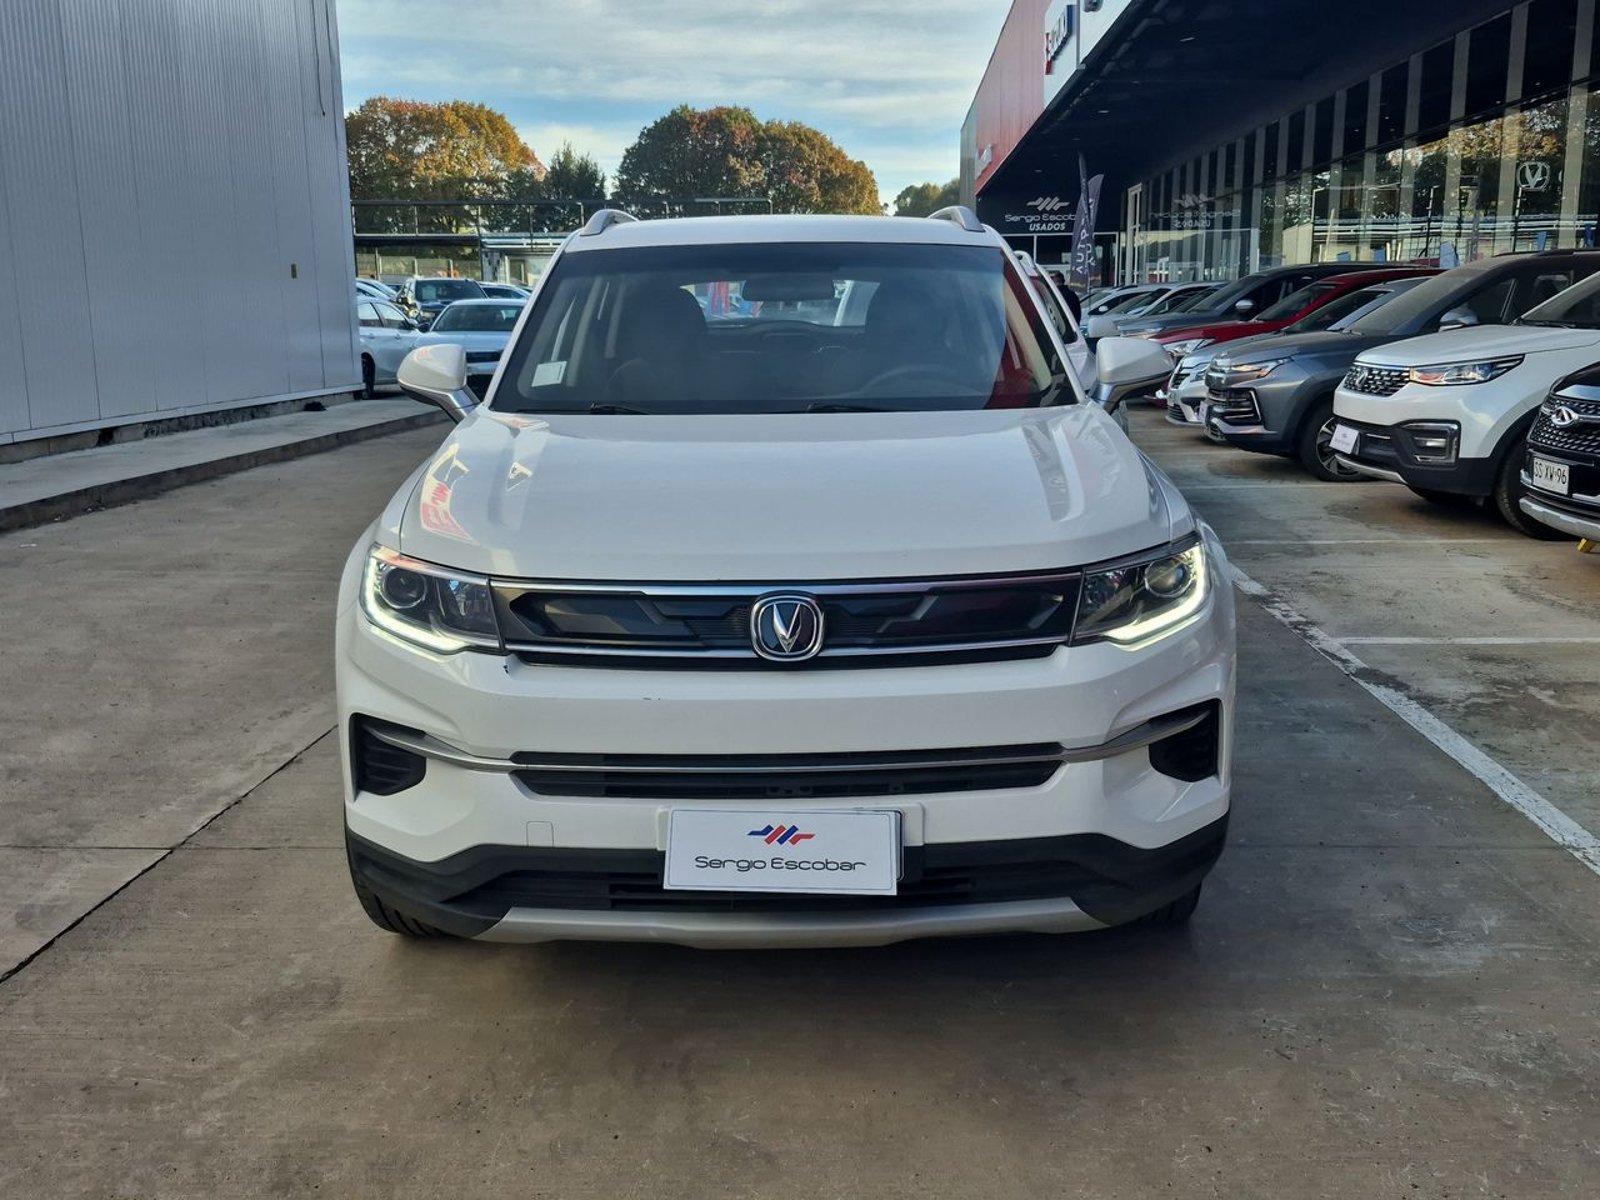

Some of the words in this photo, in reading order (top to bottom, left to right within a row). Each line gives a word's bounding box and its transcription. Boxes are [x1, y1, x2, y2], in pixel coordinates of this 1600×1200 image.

[1029, 223, 1066, 231] USADOS
[694, 855, 767, 872] Sergio
[771, 857, 867, 871] Escobar
